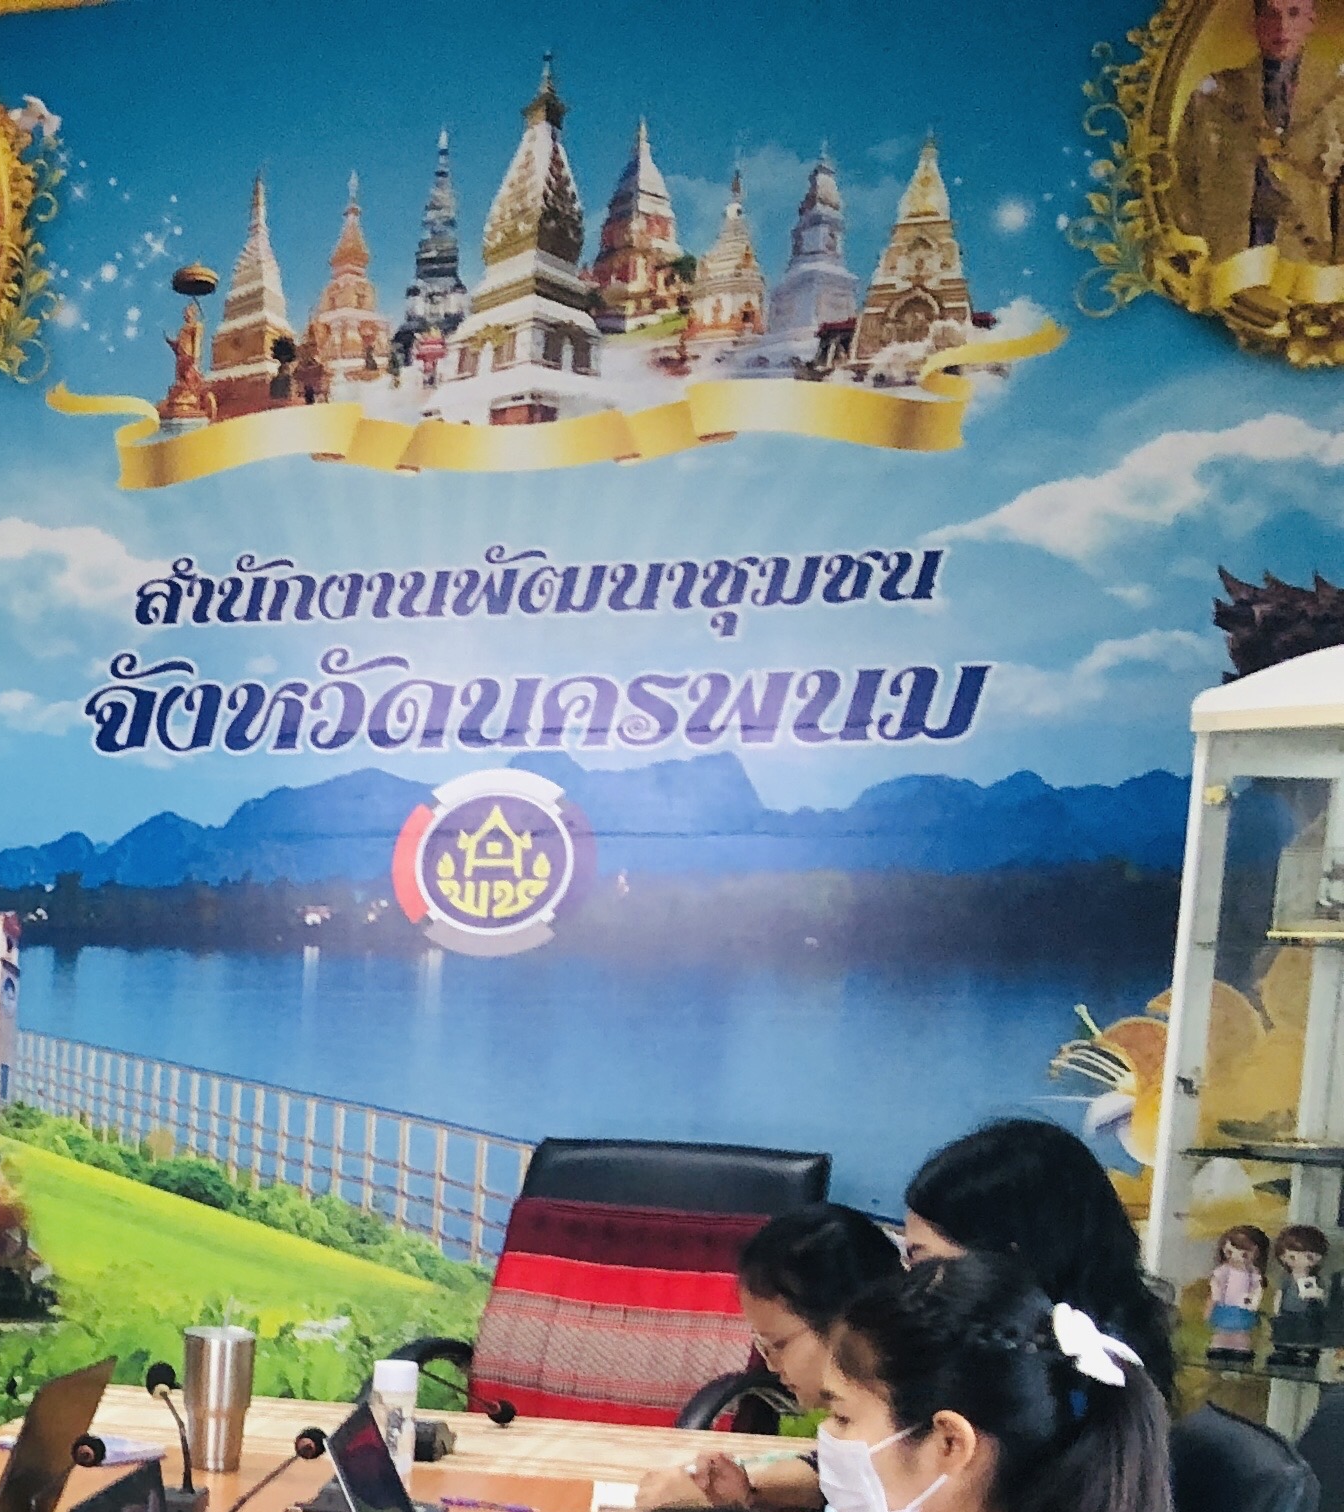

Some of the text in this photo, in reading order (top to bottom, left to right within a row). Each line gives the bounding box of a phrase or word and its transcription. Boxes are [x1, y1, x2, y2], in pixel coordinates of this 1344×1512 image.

[134, 544, 946, 638] สำนักงานพัฒนาชุมชน
[86, 646, 990, 755] จังหวัดนครพนม
